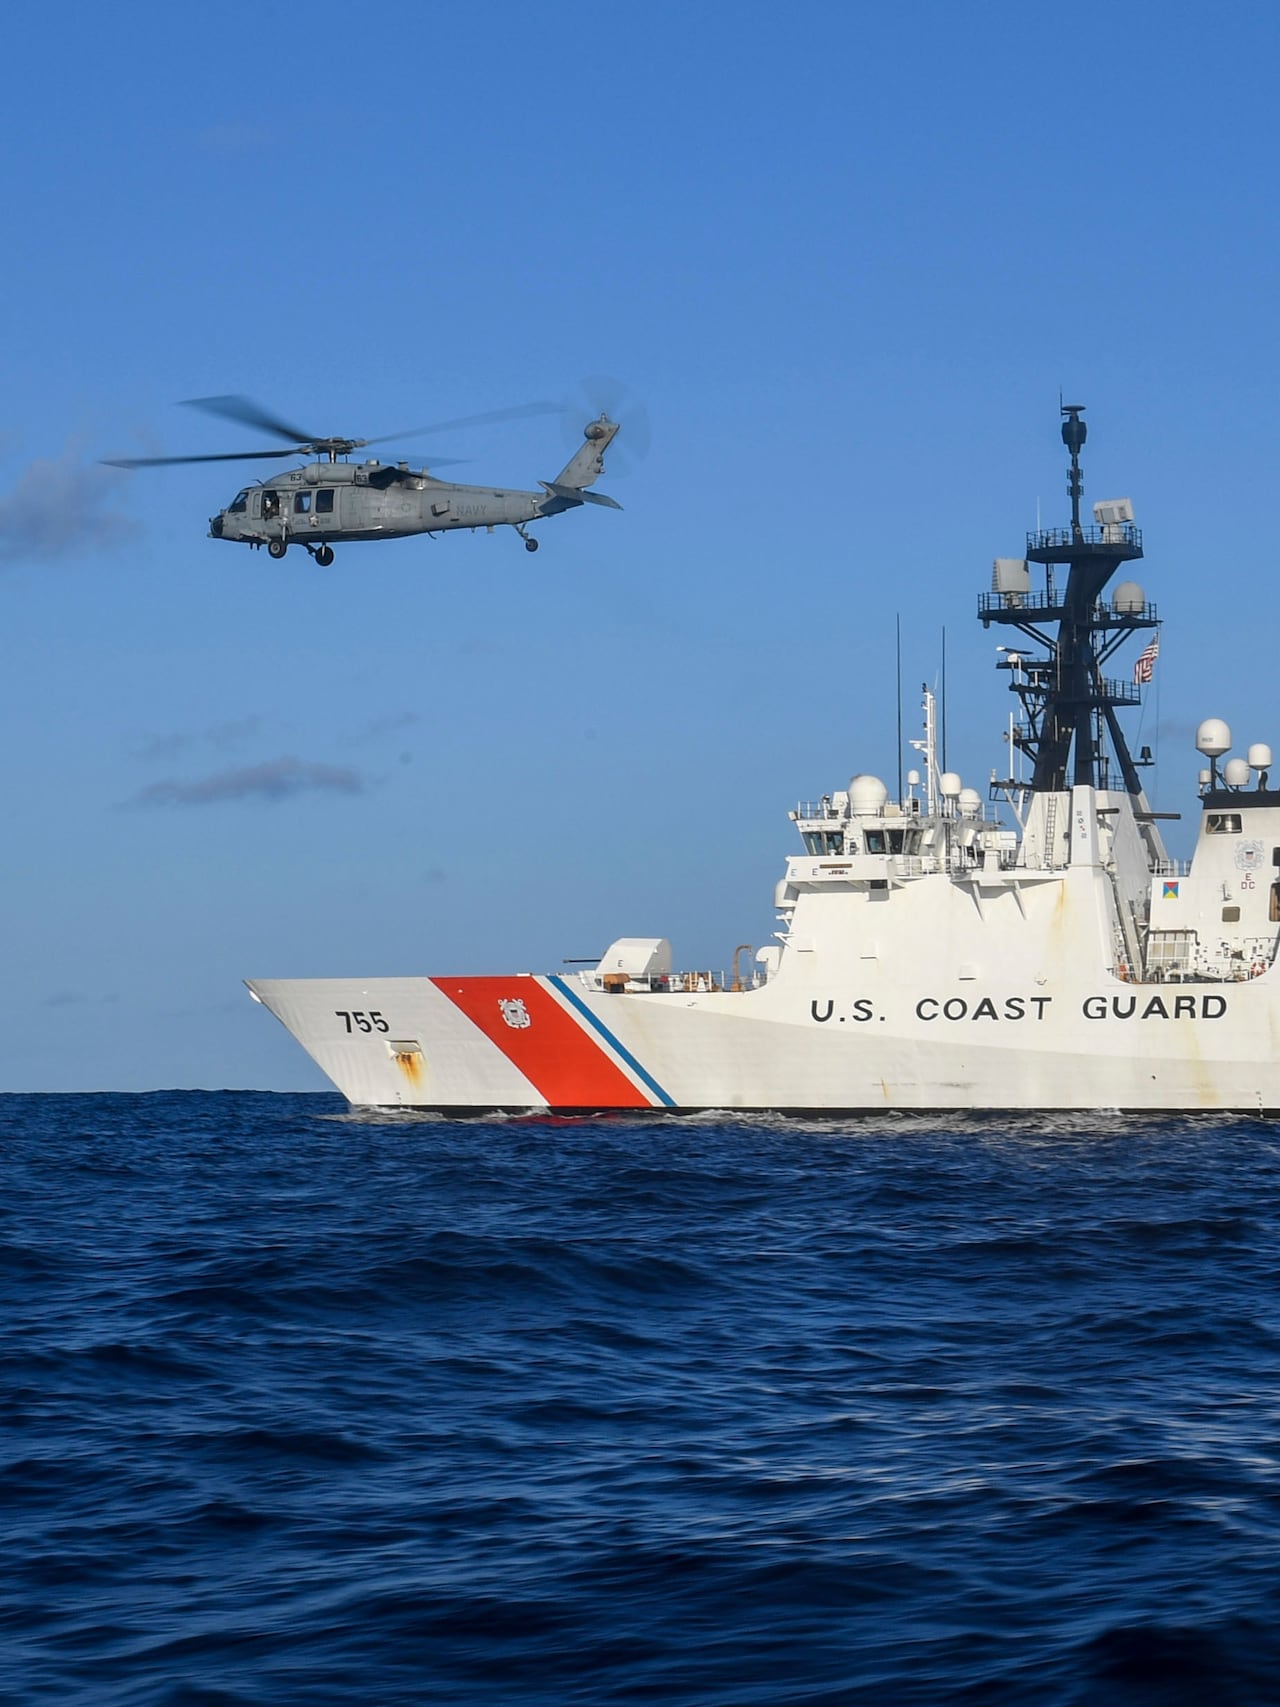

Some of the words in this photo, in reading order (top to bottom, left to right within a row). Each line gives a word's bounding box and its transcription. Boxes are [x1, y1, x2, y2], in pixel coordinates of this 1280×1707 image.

[456, 504, 487, 516] NAVY
[811, 867, 819, 876] E
[1245, 872, 1252, 881] E
[1240, 881, 1256, 890] DC
[617, 959, 624, 968] E
[811, 999, 885, 1022] U.S.
[916, 997, 1052, 1021] COAST
[1082, 995, 1227, 1020] GUARD
[335, 1011, 390, 1033] 755
